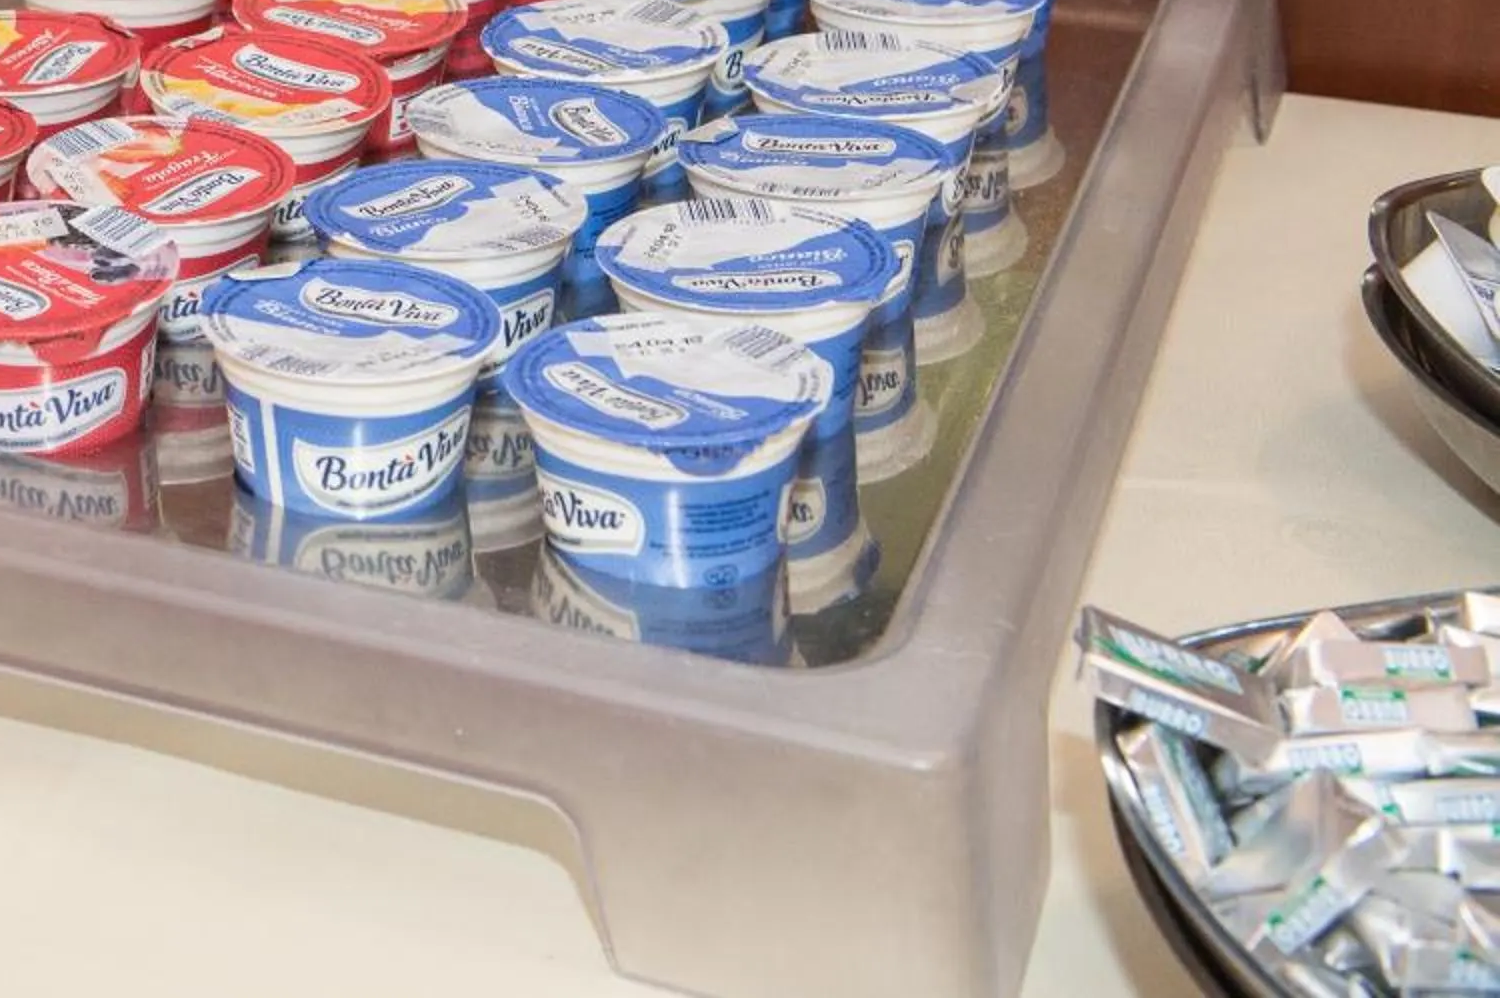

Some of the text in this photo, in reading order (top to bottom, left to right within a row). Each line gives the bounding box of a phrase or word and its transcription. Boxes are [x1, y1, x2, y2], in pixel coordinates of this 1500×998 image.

[313, 286, 443, 324] Bontà Viva
[44, 380, 117, 424] Viva
[315, 453, 416, 492] Bontà
[553, 489, 622, 530] Viva
